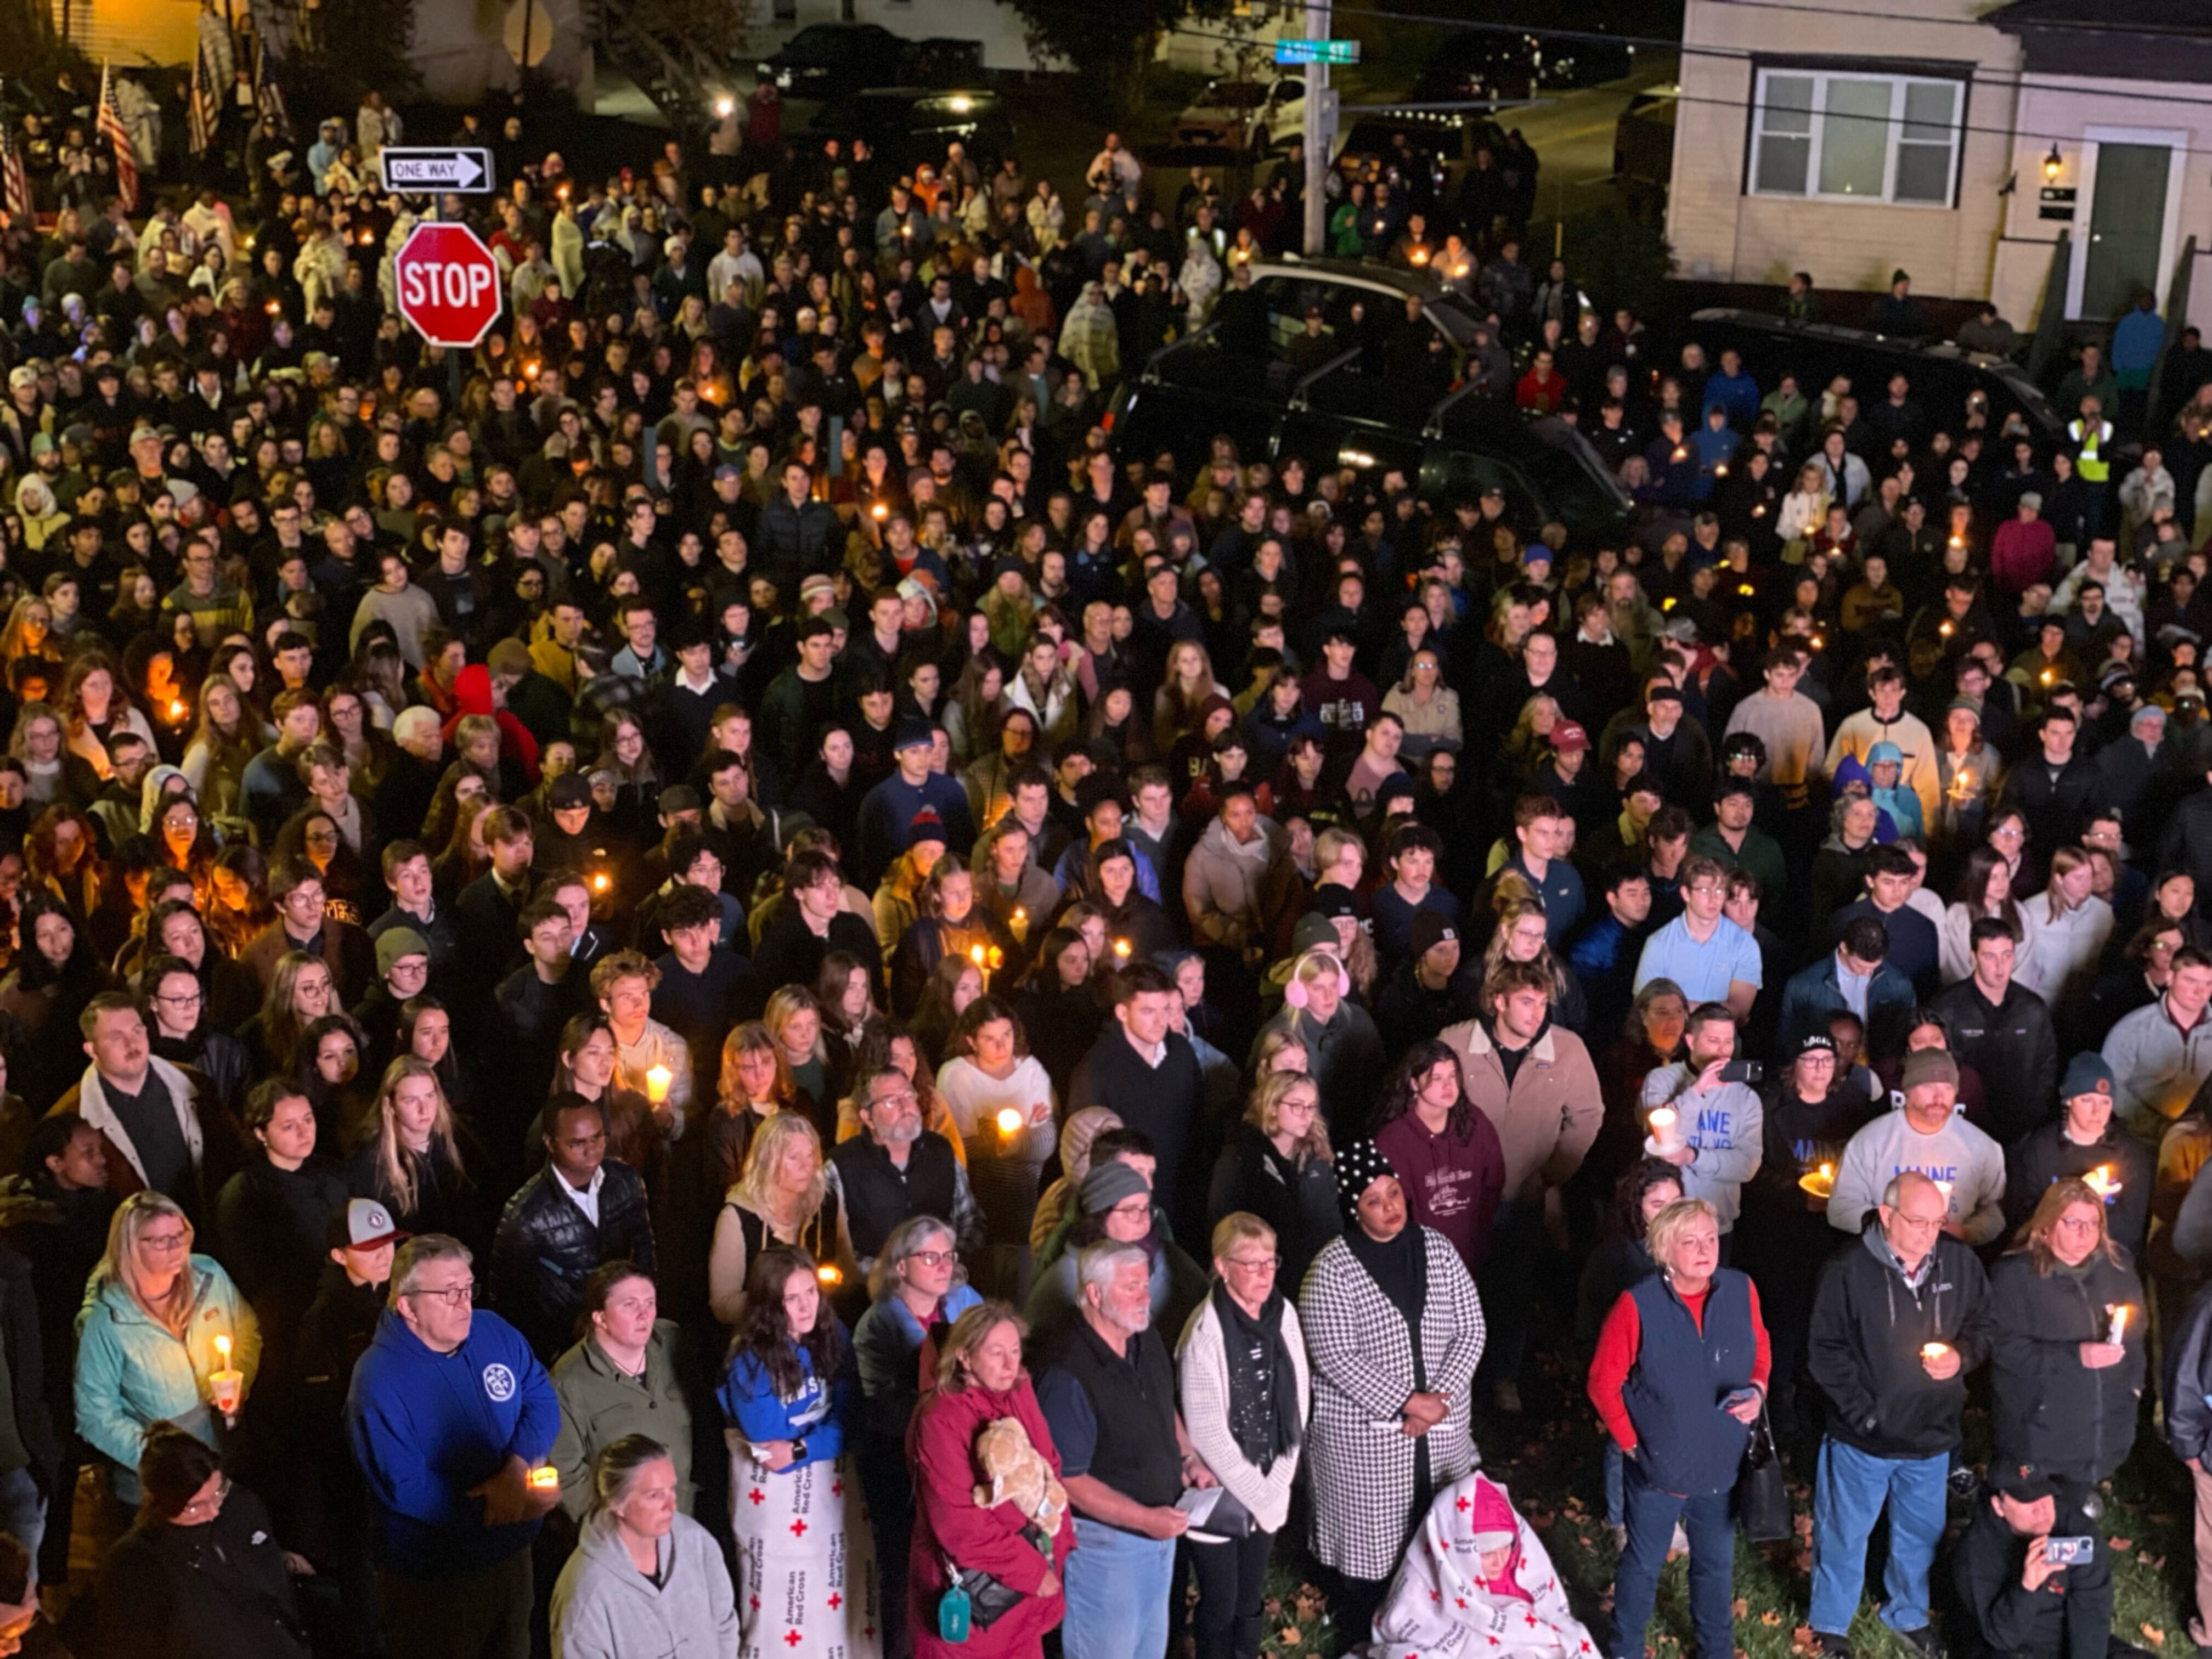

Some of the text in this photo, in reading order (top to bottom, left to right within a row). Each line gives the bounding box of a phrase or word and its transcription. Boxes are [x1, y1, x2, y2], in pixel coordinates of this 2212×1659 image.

[1328, 43, 1346, 61] ST
[395, 163, 455, 177] ONE WAY
[404, 261, 492, 308] STOP
[801, 1493, 810, 1514] Red
[785, 1571, 795, 1624] American
[795, 1571, 805, 1624] Red Cross
